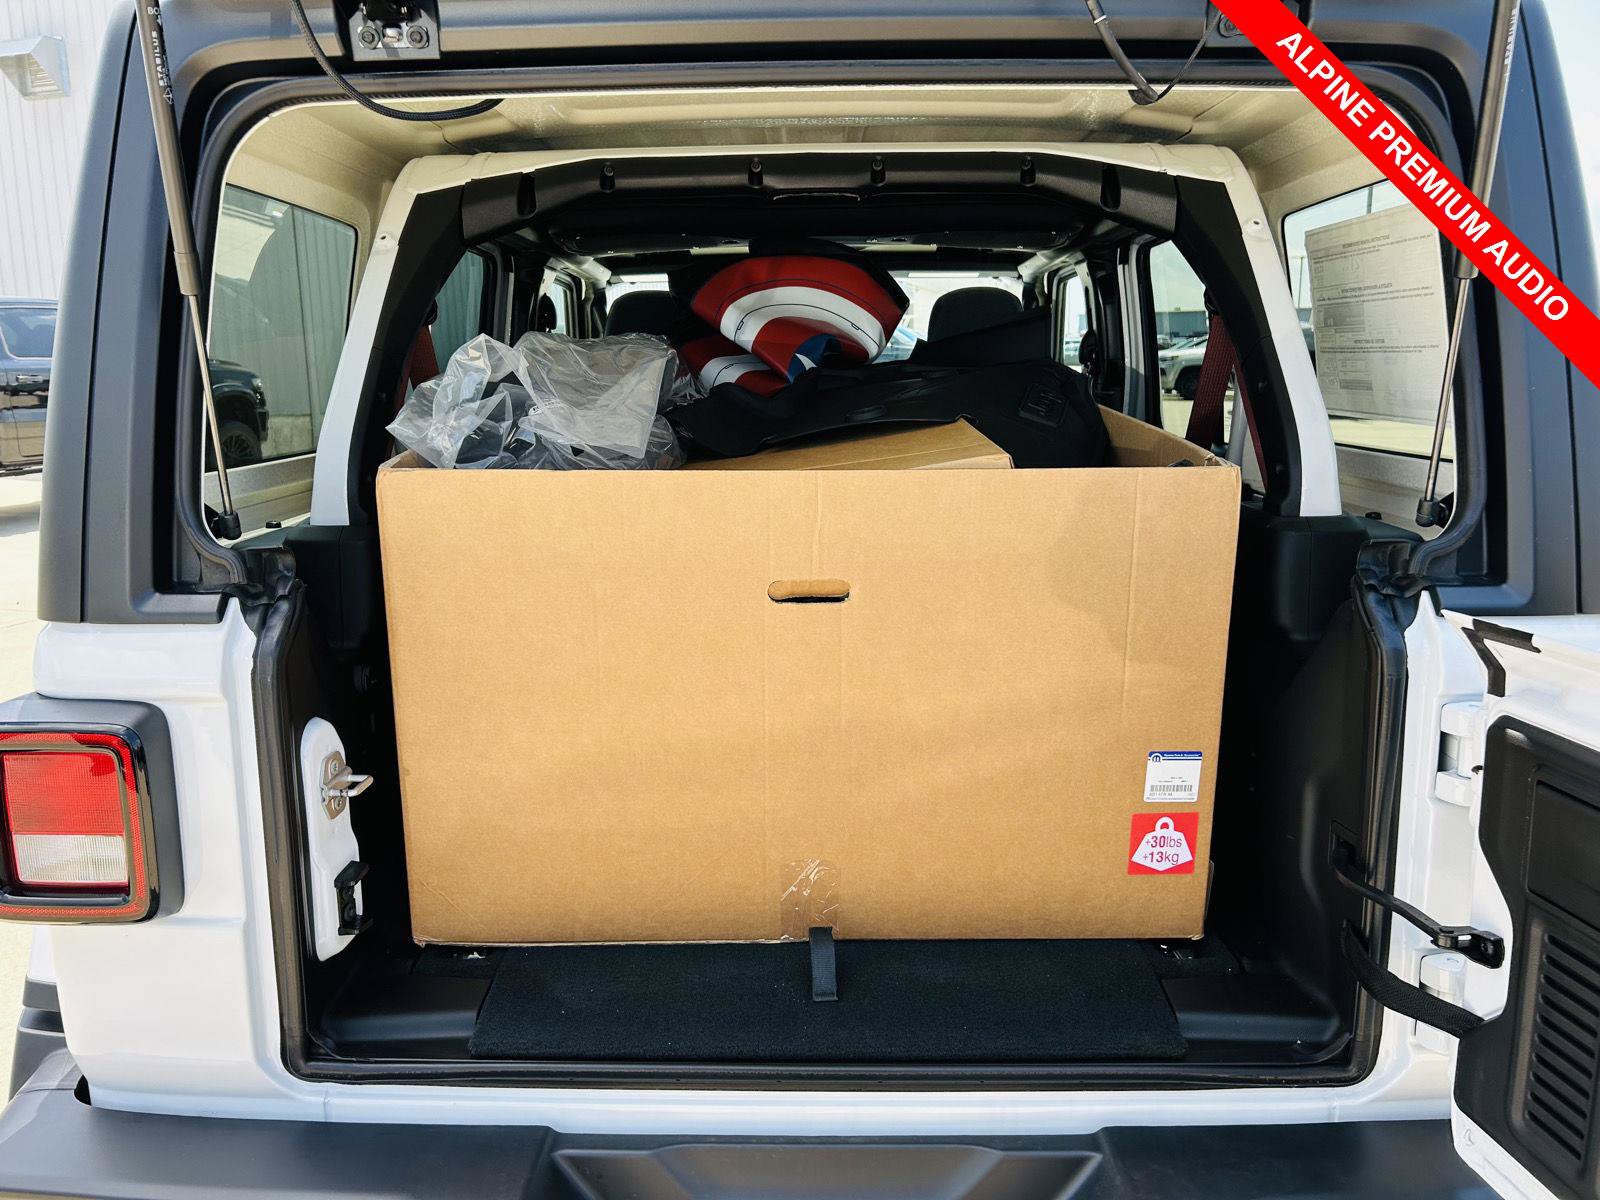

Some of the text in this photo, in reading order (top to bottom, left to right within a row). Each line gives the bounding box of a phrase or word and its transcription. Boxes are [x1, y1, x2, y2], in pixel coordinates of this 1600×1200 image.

[151, 30, 164, 86] STABILUS
[1145, 835, 1183, 848] +30lbs
[1142, 850, 1180, 866] +13kg
